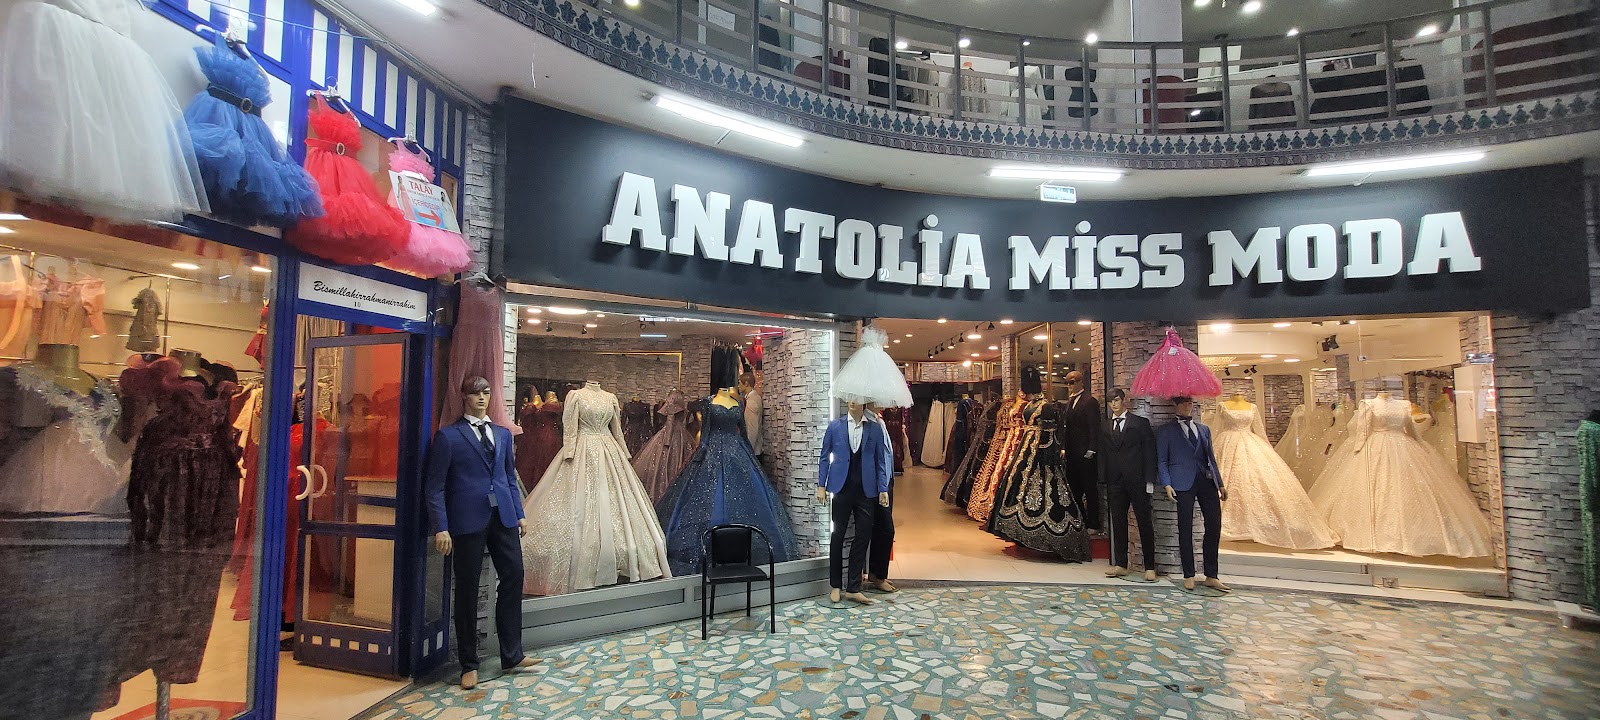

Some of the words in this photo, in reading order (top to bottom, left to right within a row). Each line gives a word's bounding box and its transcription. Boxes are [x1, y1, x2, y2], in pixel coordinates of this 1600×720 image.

[408, 180, 433, 195] TALAY
[602, 171, 991, 290] ANATOLİA
[1008, 220, 1185, 290] MİSS
[1208, 211, 1481, 286] MODA
[313, 280, 416, 310] Bismillahirrahmanirrahim
